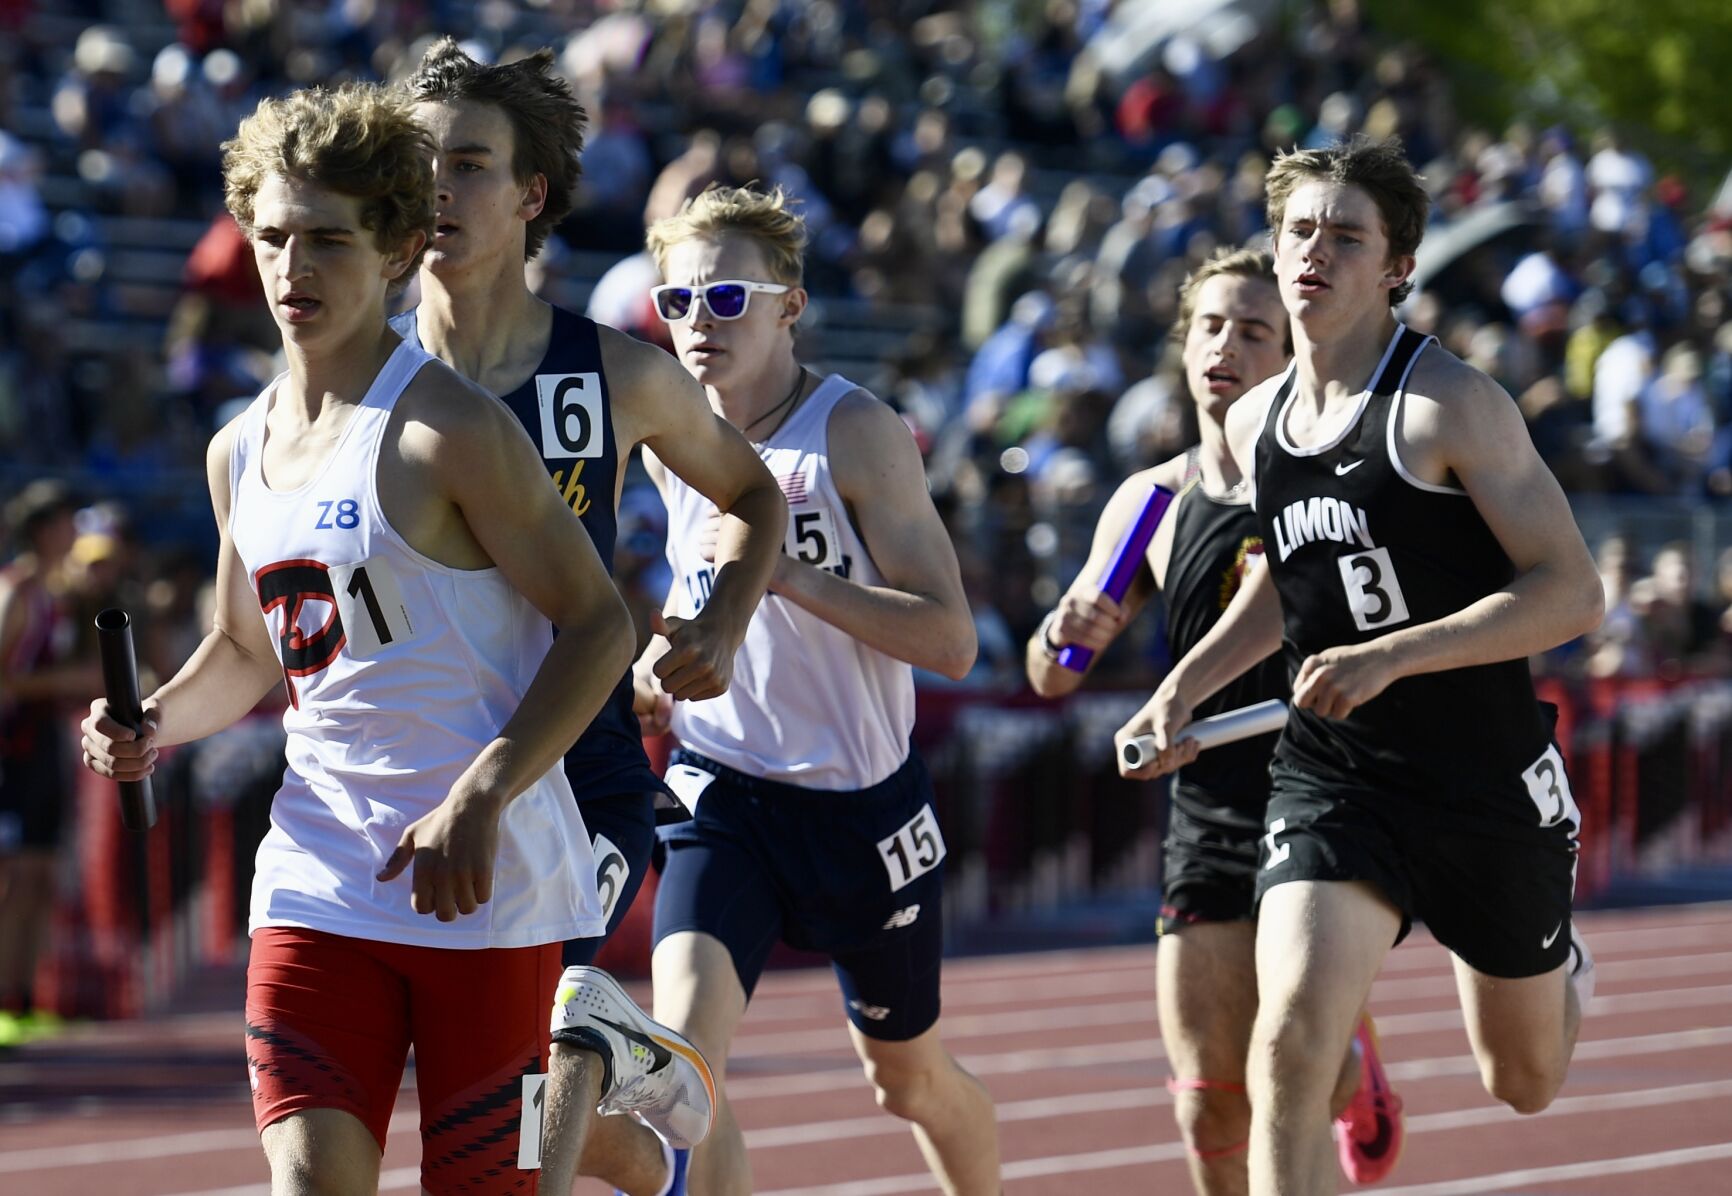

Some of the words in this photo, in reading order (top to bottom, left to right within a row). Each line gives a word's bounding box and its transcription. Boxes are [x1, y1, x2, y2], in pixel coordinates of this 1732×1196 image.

[553, 377, 591, 453] 6
[314, 498, 360, 530] Z8
[1272, 496, 1377, 563] LIMON
[346, 566, 394, 645] 1
[1351, 555, 1393, 624] 3
[1534, 758, 1565, 824] 3
[887, 815, 938, 881] 15
